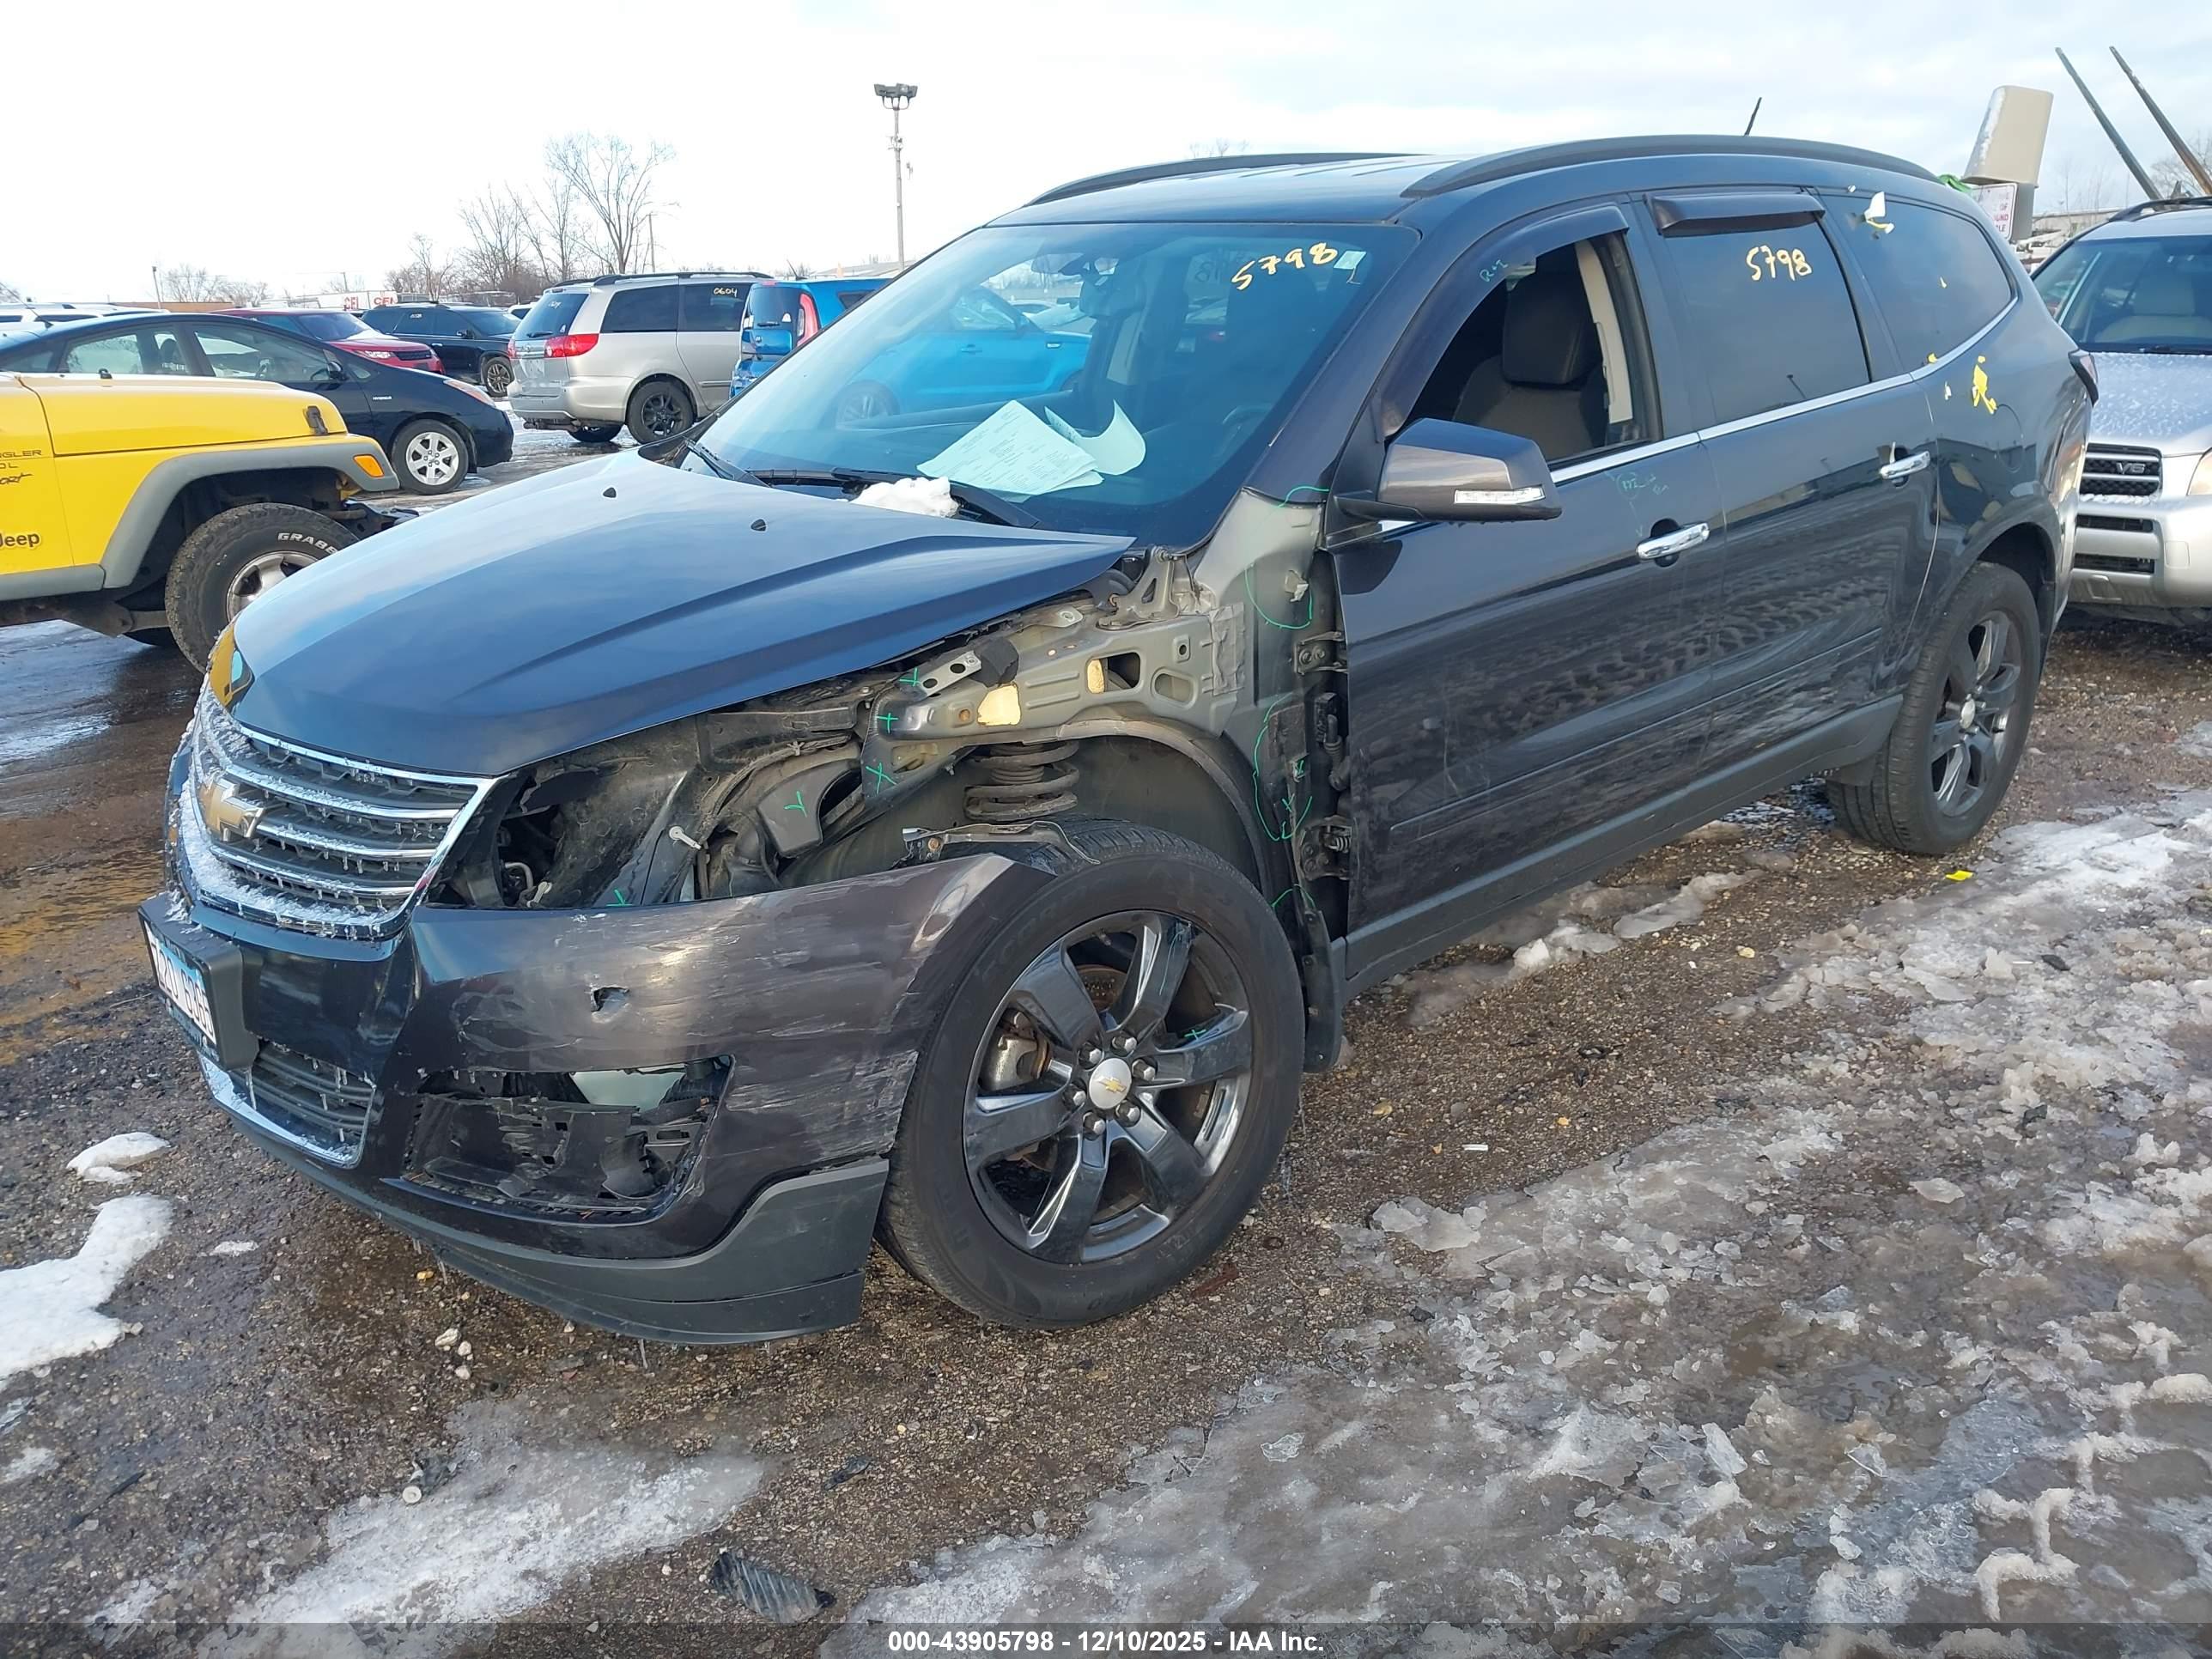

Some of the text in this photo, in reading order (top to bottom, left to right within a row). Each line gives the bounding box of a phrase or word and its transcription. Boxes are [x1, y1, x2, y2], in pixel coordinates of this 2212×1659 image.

[1231, 242, 1338, 290] 5798
[1746, 245, 1813, 282] 5798
[714, 288, 738, 298] 0604
[2117, 462, 2146, 475] V6
